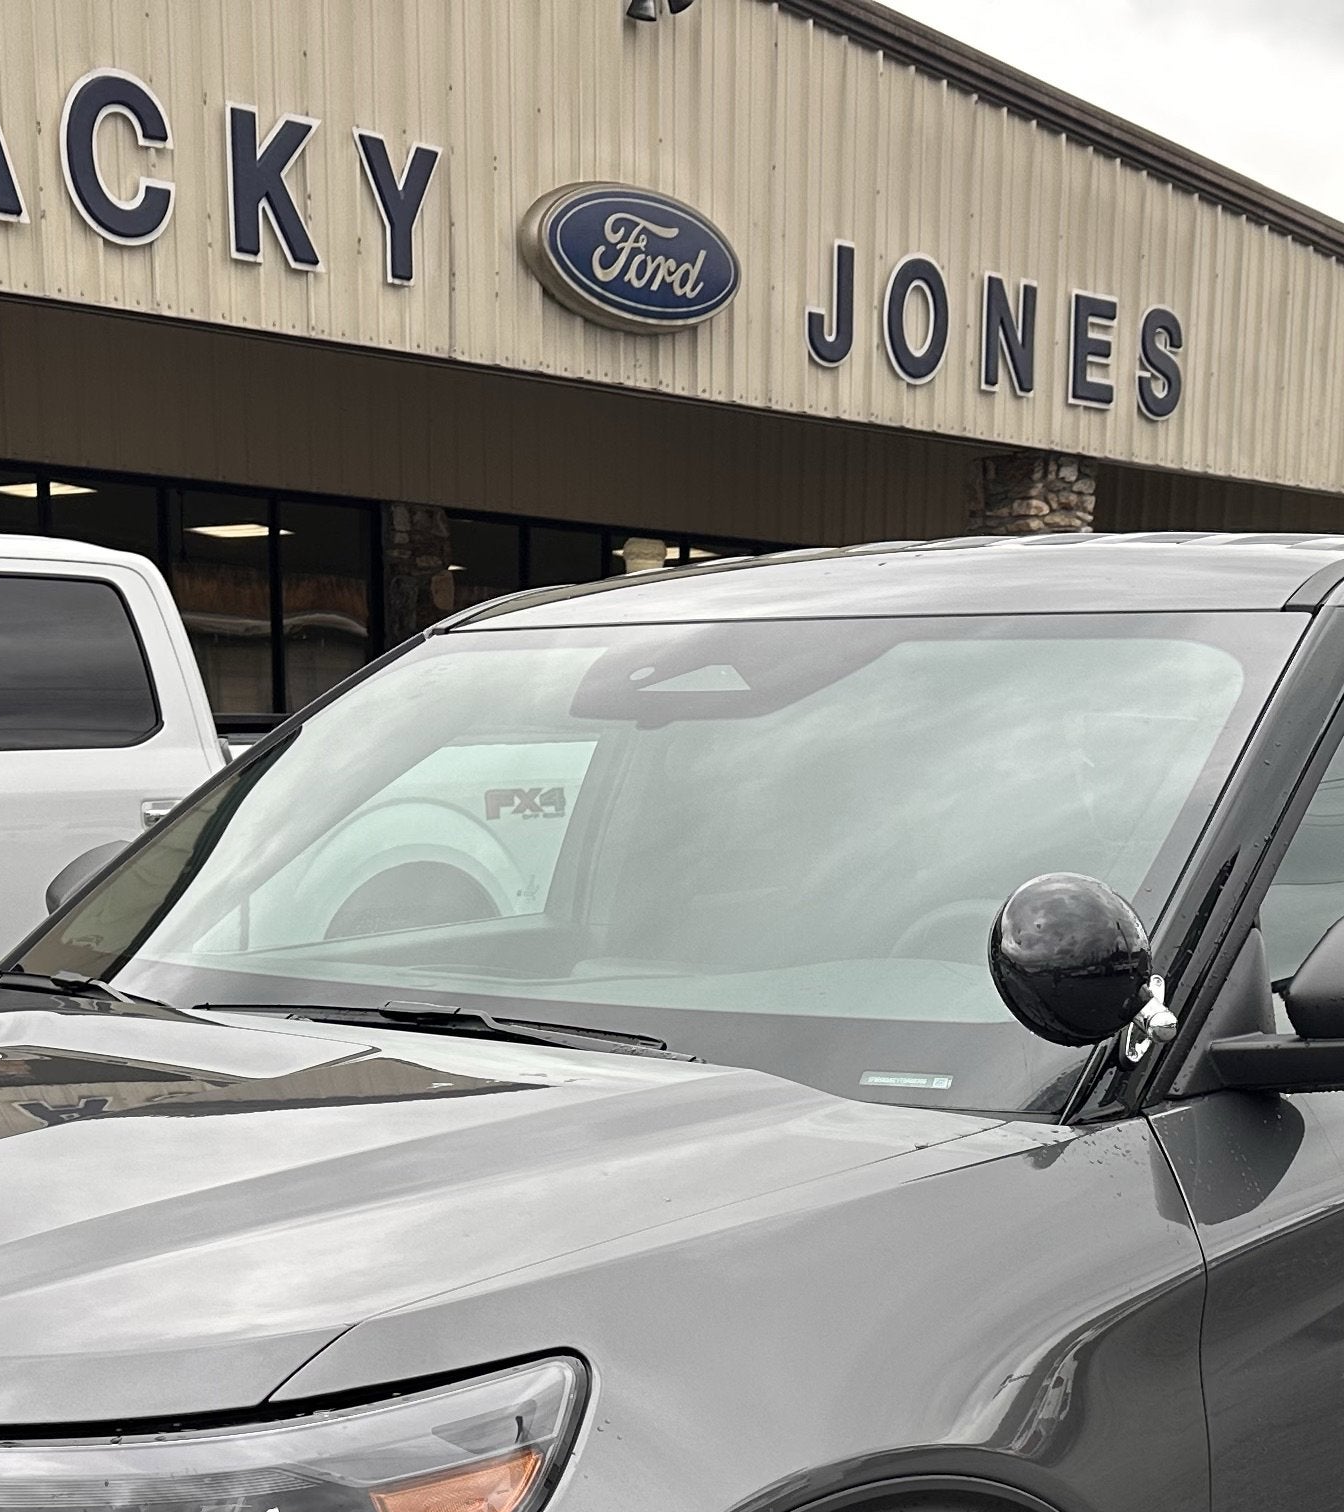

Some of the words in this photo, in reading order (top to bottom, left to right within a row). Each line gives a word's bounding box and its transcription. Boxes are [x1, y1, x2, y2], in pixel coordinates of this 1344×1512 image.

[592, 212, 706, 299] Ford
[806, 238, 1186, 421] JONES
[484, 787, 565, 820] FX4
